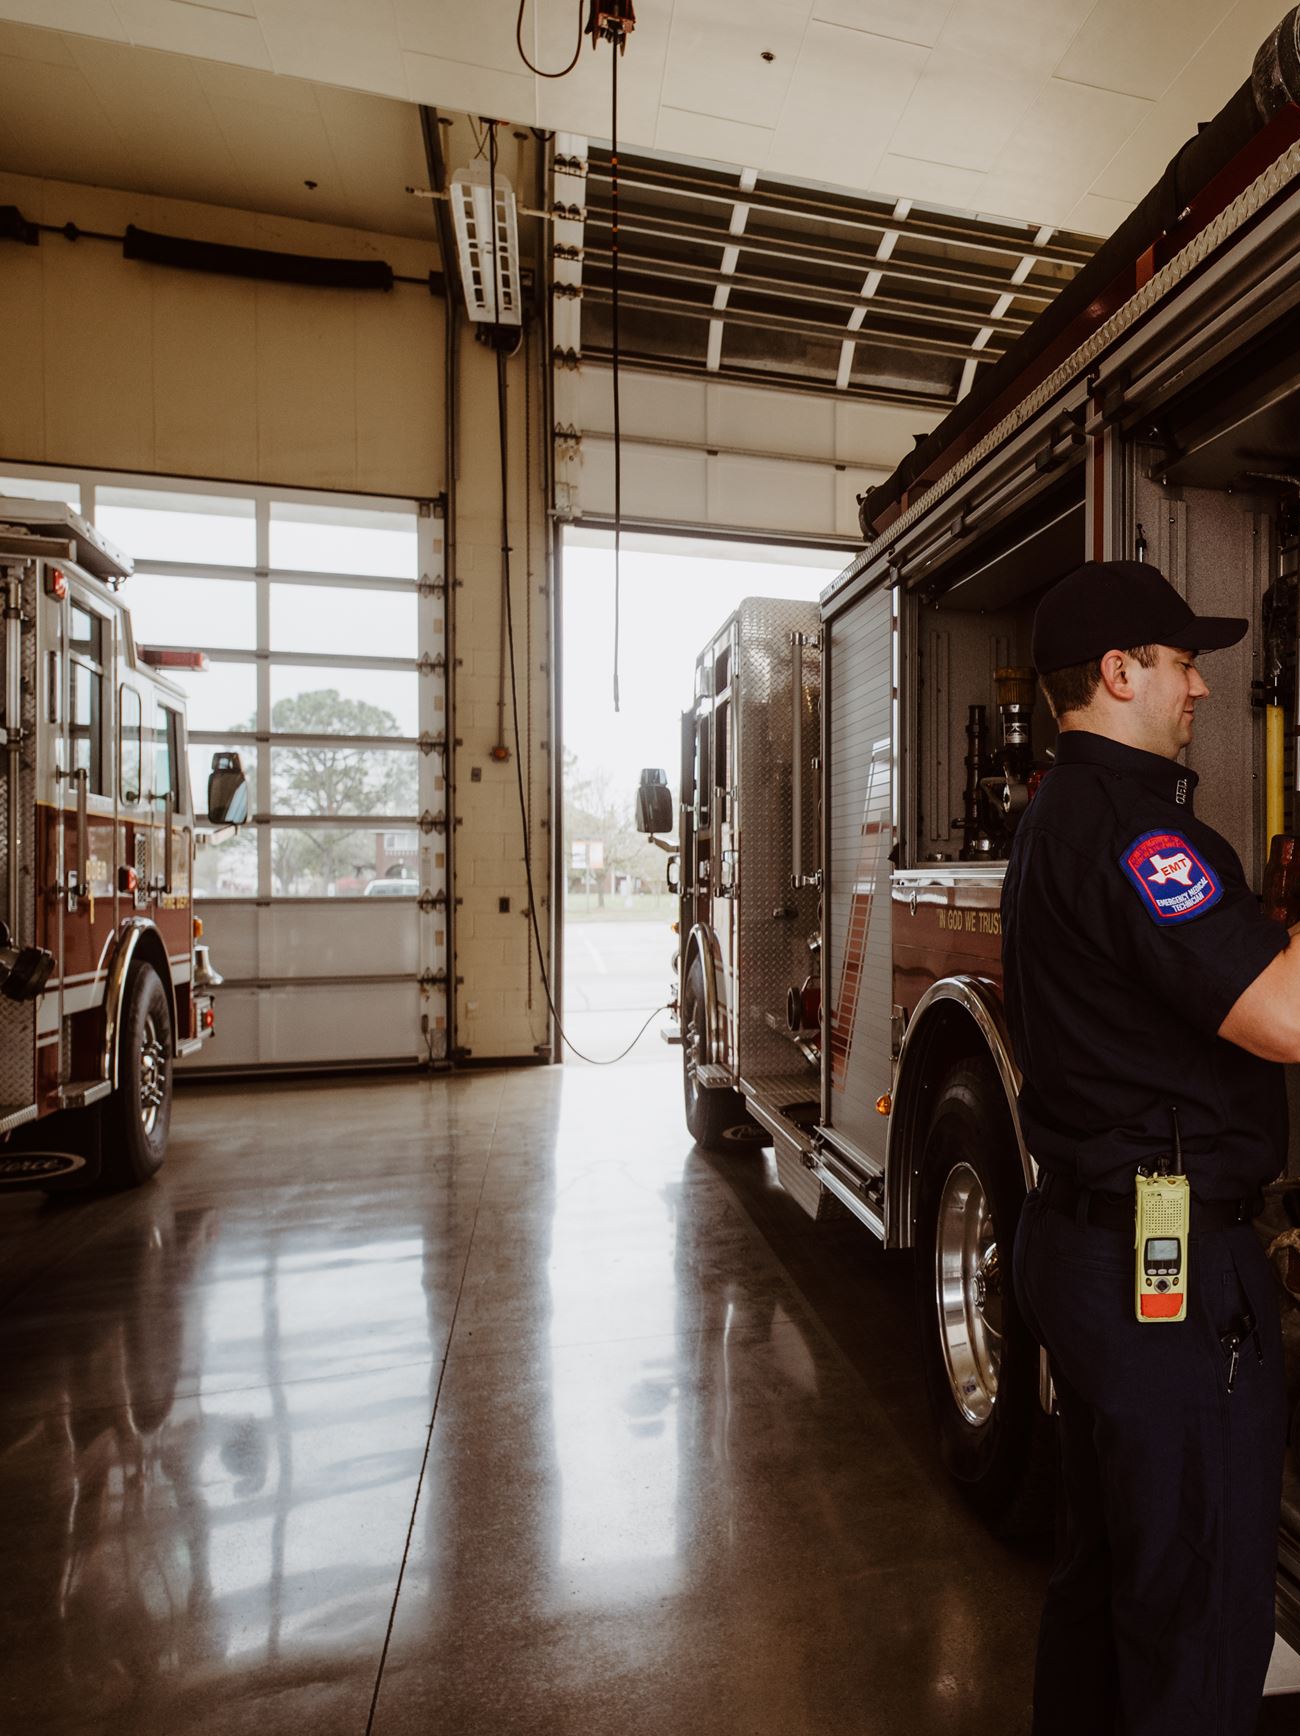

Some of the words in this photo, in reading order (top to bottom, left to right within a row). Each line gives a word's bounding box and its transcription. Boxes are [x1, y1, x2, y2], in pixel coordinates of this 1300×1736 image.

[1160, 857, 1187, 876] EMT
[1155, 891, 1190, 907] EMERGENCY
[1187, 876, 1209, 896] MEDICAL
[1171, 891, 1205, 913] TECHNICIAN
[947, 909, 963, 930] GOD
[965, 911, 976, 932] WE
